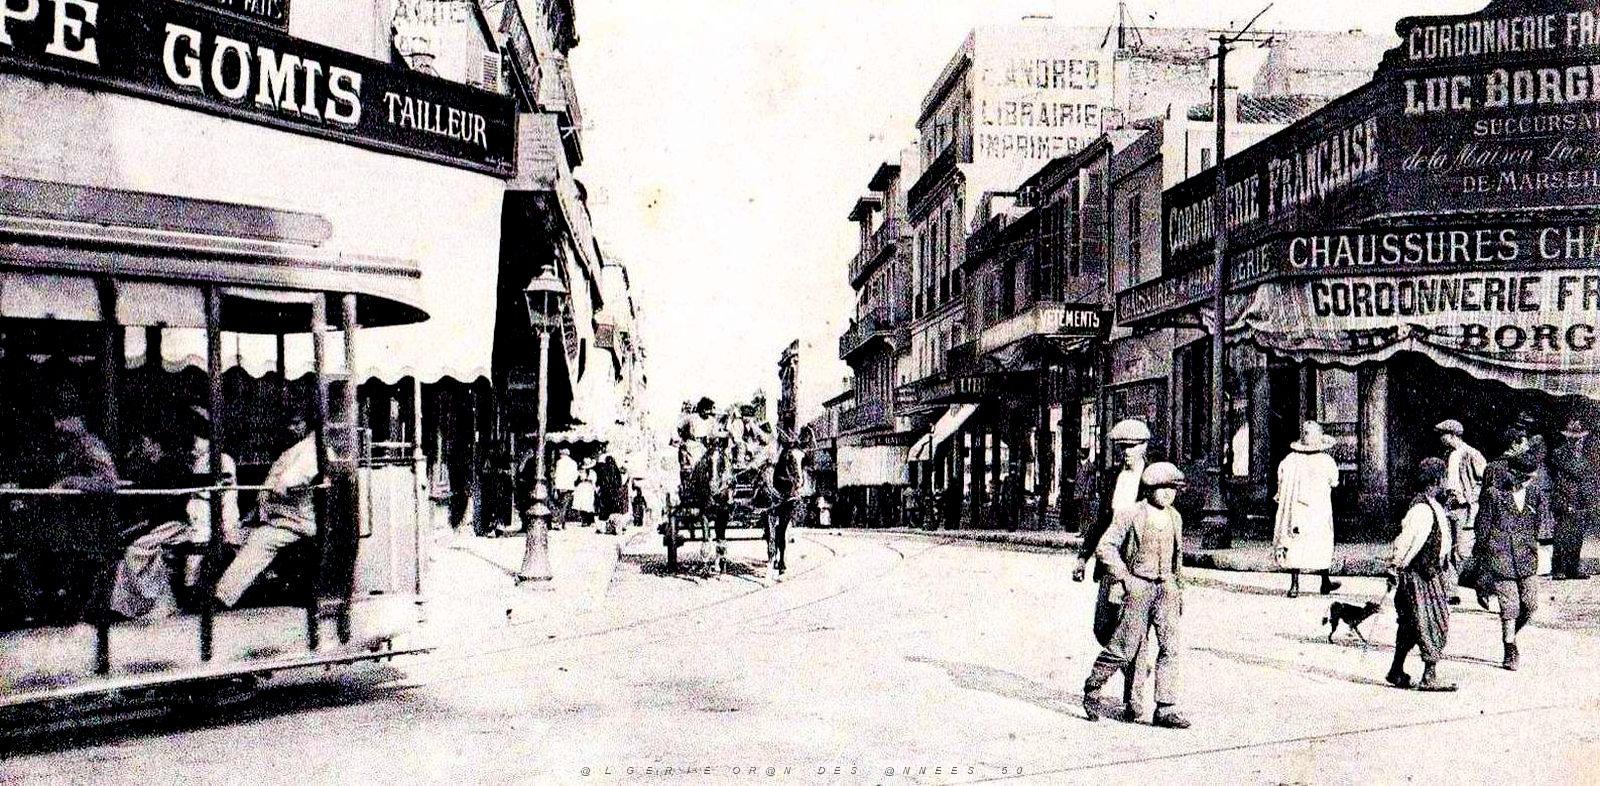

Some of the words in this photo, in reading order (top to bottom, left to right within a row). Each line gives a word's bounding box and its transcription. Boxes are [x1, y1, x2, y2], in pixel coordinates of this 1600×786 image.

[1409, 14, 1556, 60] CORDONNERIE
[163, 22, 362, 129] GOMIS
[383, 92, 488, 149] TAILLEUR
[1404, 75, 1471, 115] LUC
[982, 100, 1097, 129] LIBRAIRIE
[1462, 175, 1490, 193] DE
[1289, 228, 1519, 268] CHAUSSURES
[1311, 276, 1541, 317] CORDONNERIE
